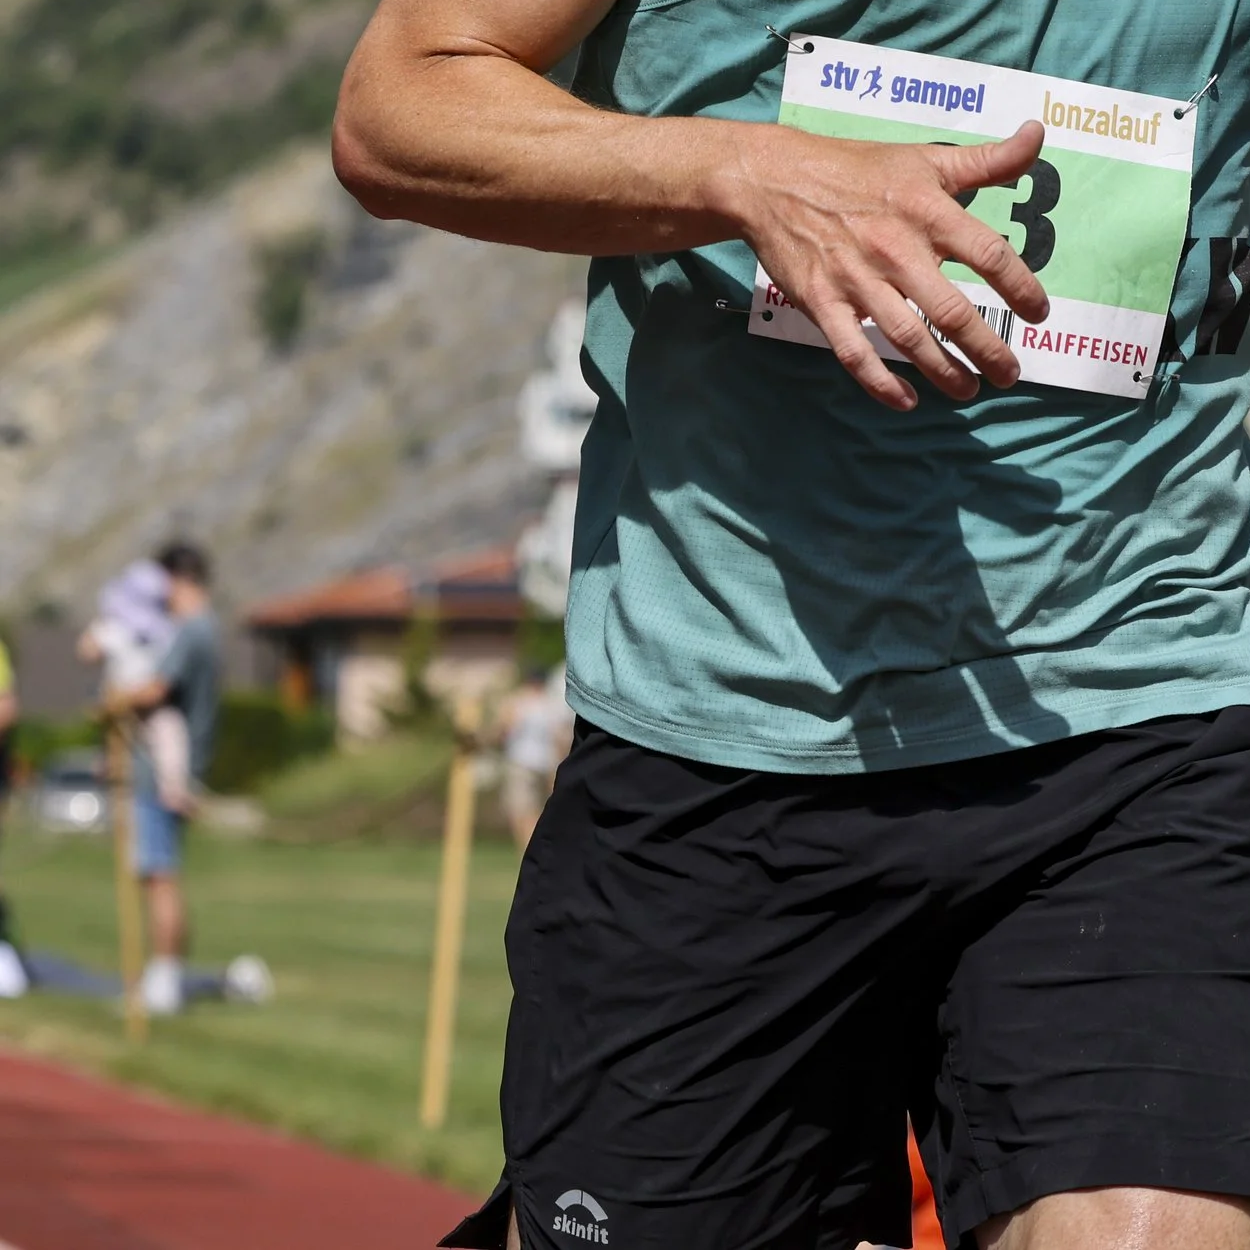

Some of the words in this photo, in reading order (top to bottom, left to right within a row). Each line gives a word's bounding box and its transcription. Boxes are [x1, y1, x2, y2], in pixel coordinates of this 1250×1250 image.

[820, 61, 860, 91] stv
[890, 75, 986, 113] gampel
[1042, 90, 1162, 146] lonzalauf
[1021, 326, 1148, 367] RAIFFEISEN
[552, 1213, 609, 1245] skinfit
